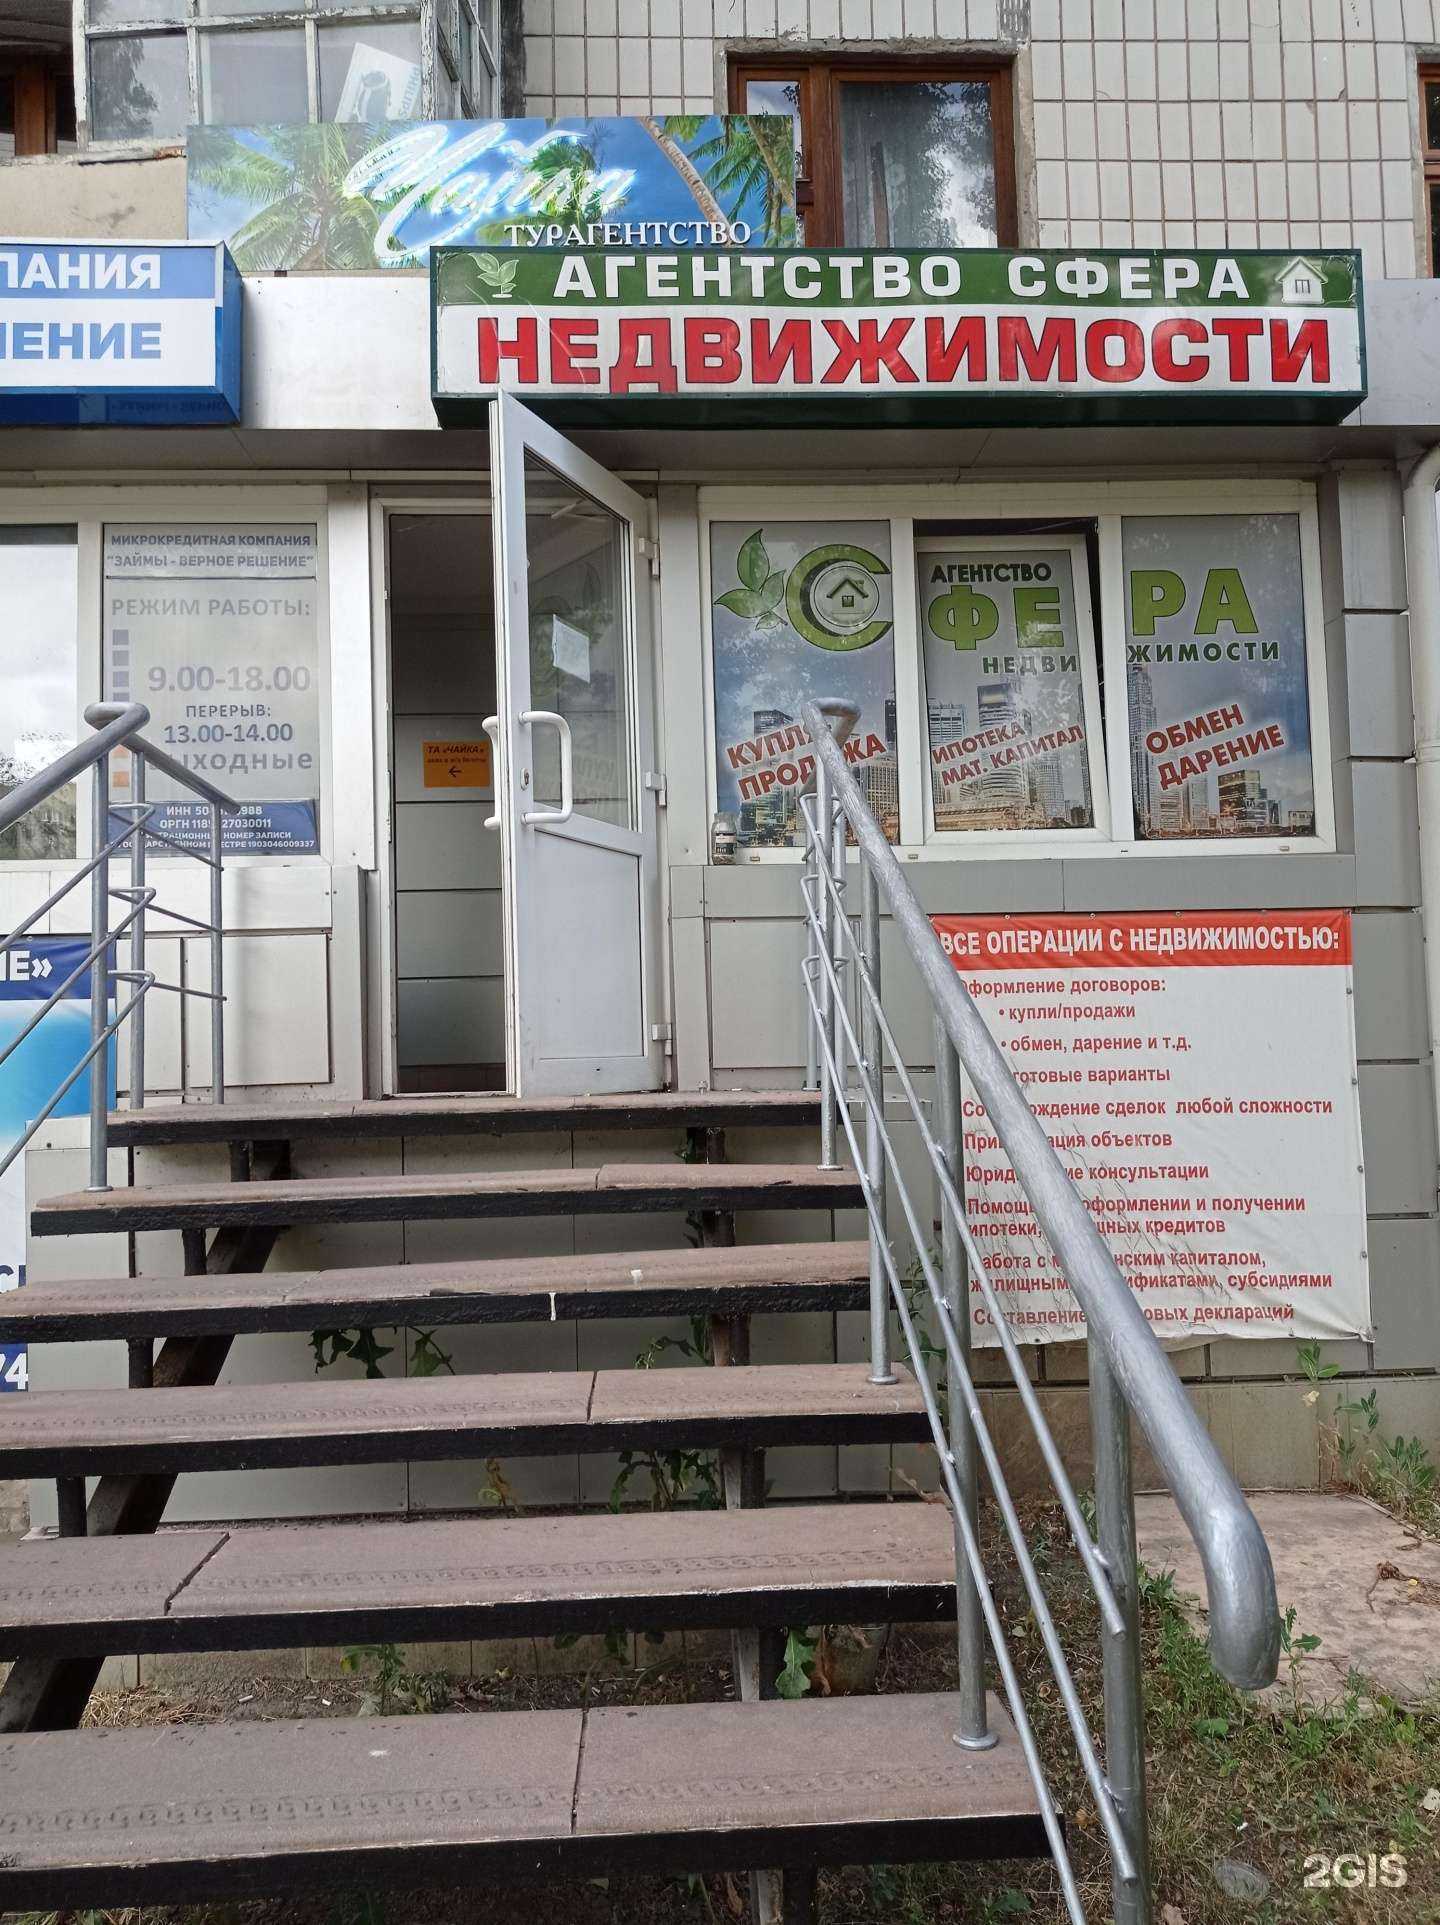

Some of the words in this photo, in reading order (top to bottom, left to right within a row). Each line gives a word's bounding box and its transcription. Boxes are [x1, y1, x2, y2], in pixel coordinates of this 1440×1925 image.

[504, 221, 752, 247] ТУРАГЕНТСТВО
[553, 255, 961, 299] АГЕНТСТВО
[1007, 256, 1250, 299] СФЕРА
[0, 323, 161, 359] ЕНИЕ
[477, 316, 1331, 393] НЕДВИЖИМОСТИ
[111, 535, 236, 547] МИКРОКРЕДИТНАЯ
[238, 535, 311, 546] КОМПАНИЯ
[179, 555, 235, 567] ВЕРНОЕ
[930, 563, 1052, 583] АГЕНТСТВО
[111, 599, 200, 616] РЕЖИМ
[208, 599, 311, 616] РАБОТЫ:
[148, 666, 311, 691] 9.00-18.00
[186, 704, 271, 717] ПЕРЕРЫВ:
[164, 723, 293, 743] 13.00-14.00
[1146, 703, 1245, 754] ОБМЕН
[727, 724, 814, 769] КУПЛ
[932, 721, 1026, 764] ИПОТЕКА
[941, 759, 988, 786] МАТ.
[990, 725, 1084, 769] КАПИТАЛ
[1157, 724, 1285, 790] ДАРЕНИЕ
[738, 733, 887, 800] ПРОДЖА
[166, 806, 191, 816] ИНН
[255, 831, 292, 839] ЗАПИСИ
[939, 931, 981, 955] ВСЕ
[986, 928, 1103, 956] ОПЕРАЦИИ
[1109, 928, 1123, 952] С
[1129, 926, 1339, 955] НЕДВИЖИМОСТЬЮ:
[961, 979, 1065, 998] формление
[1070, 979, 1166, 995] договоров:
[1009, 1003, 1136, 1023] купли/продажи
[1010, 1035, 1068, 1053] обмен,
[1072, 1036, 1142, 1054] дарение
[1147, 1037, 1158, 1049] и
[1162, 1037, 1192, 1051] т.д.
[1088, 1068, 1170, 1085] варианты
[1106, 1101, 1166, 1118] сделок
[1175, 1097, 1234, 1114] любой
[1239, 1100, 1333, 1114] сложности
[1091, 1131, 1173, 1148] объектов
[1089, 1165, 1209, 1183] консультации
[1196, 1198, 1206, 1210] и
[1212, 1197, 1305, 1214] получении
[1145, 1219, 1226, 1236] кредитов
[981, 1252, 1032, 1269] абота
[1037, 1255, 1046, 1268] с
[1170, 1251, 1266, 1268] капиталом,
[1227, 1271, 1332, 1292] субсидиями
[1193, 1303, 1294, 1324] деклараций
